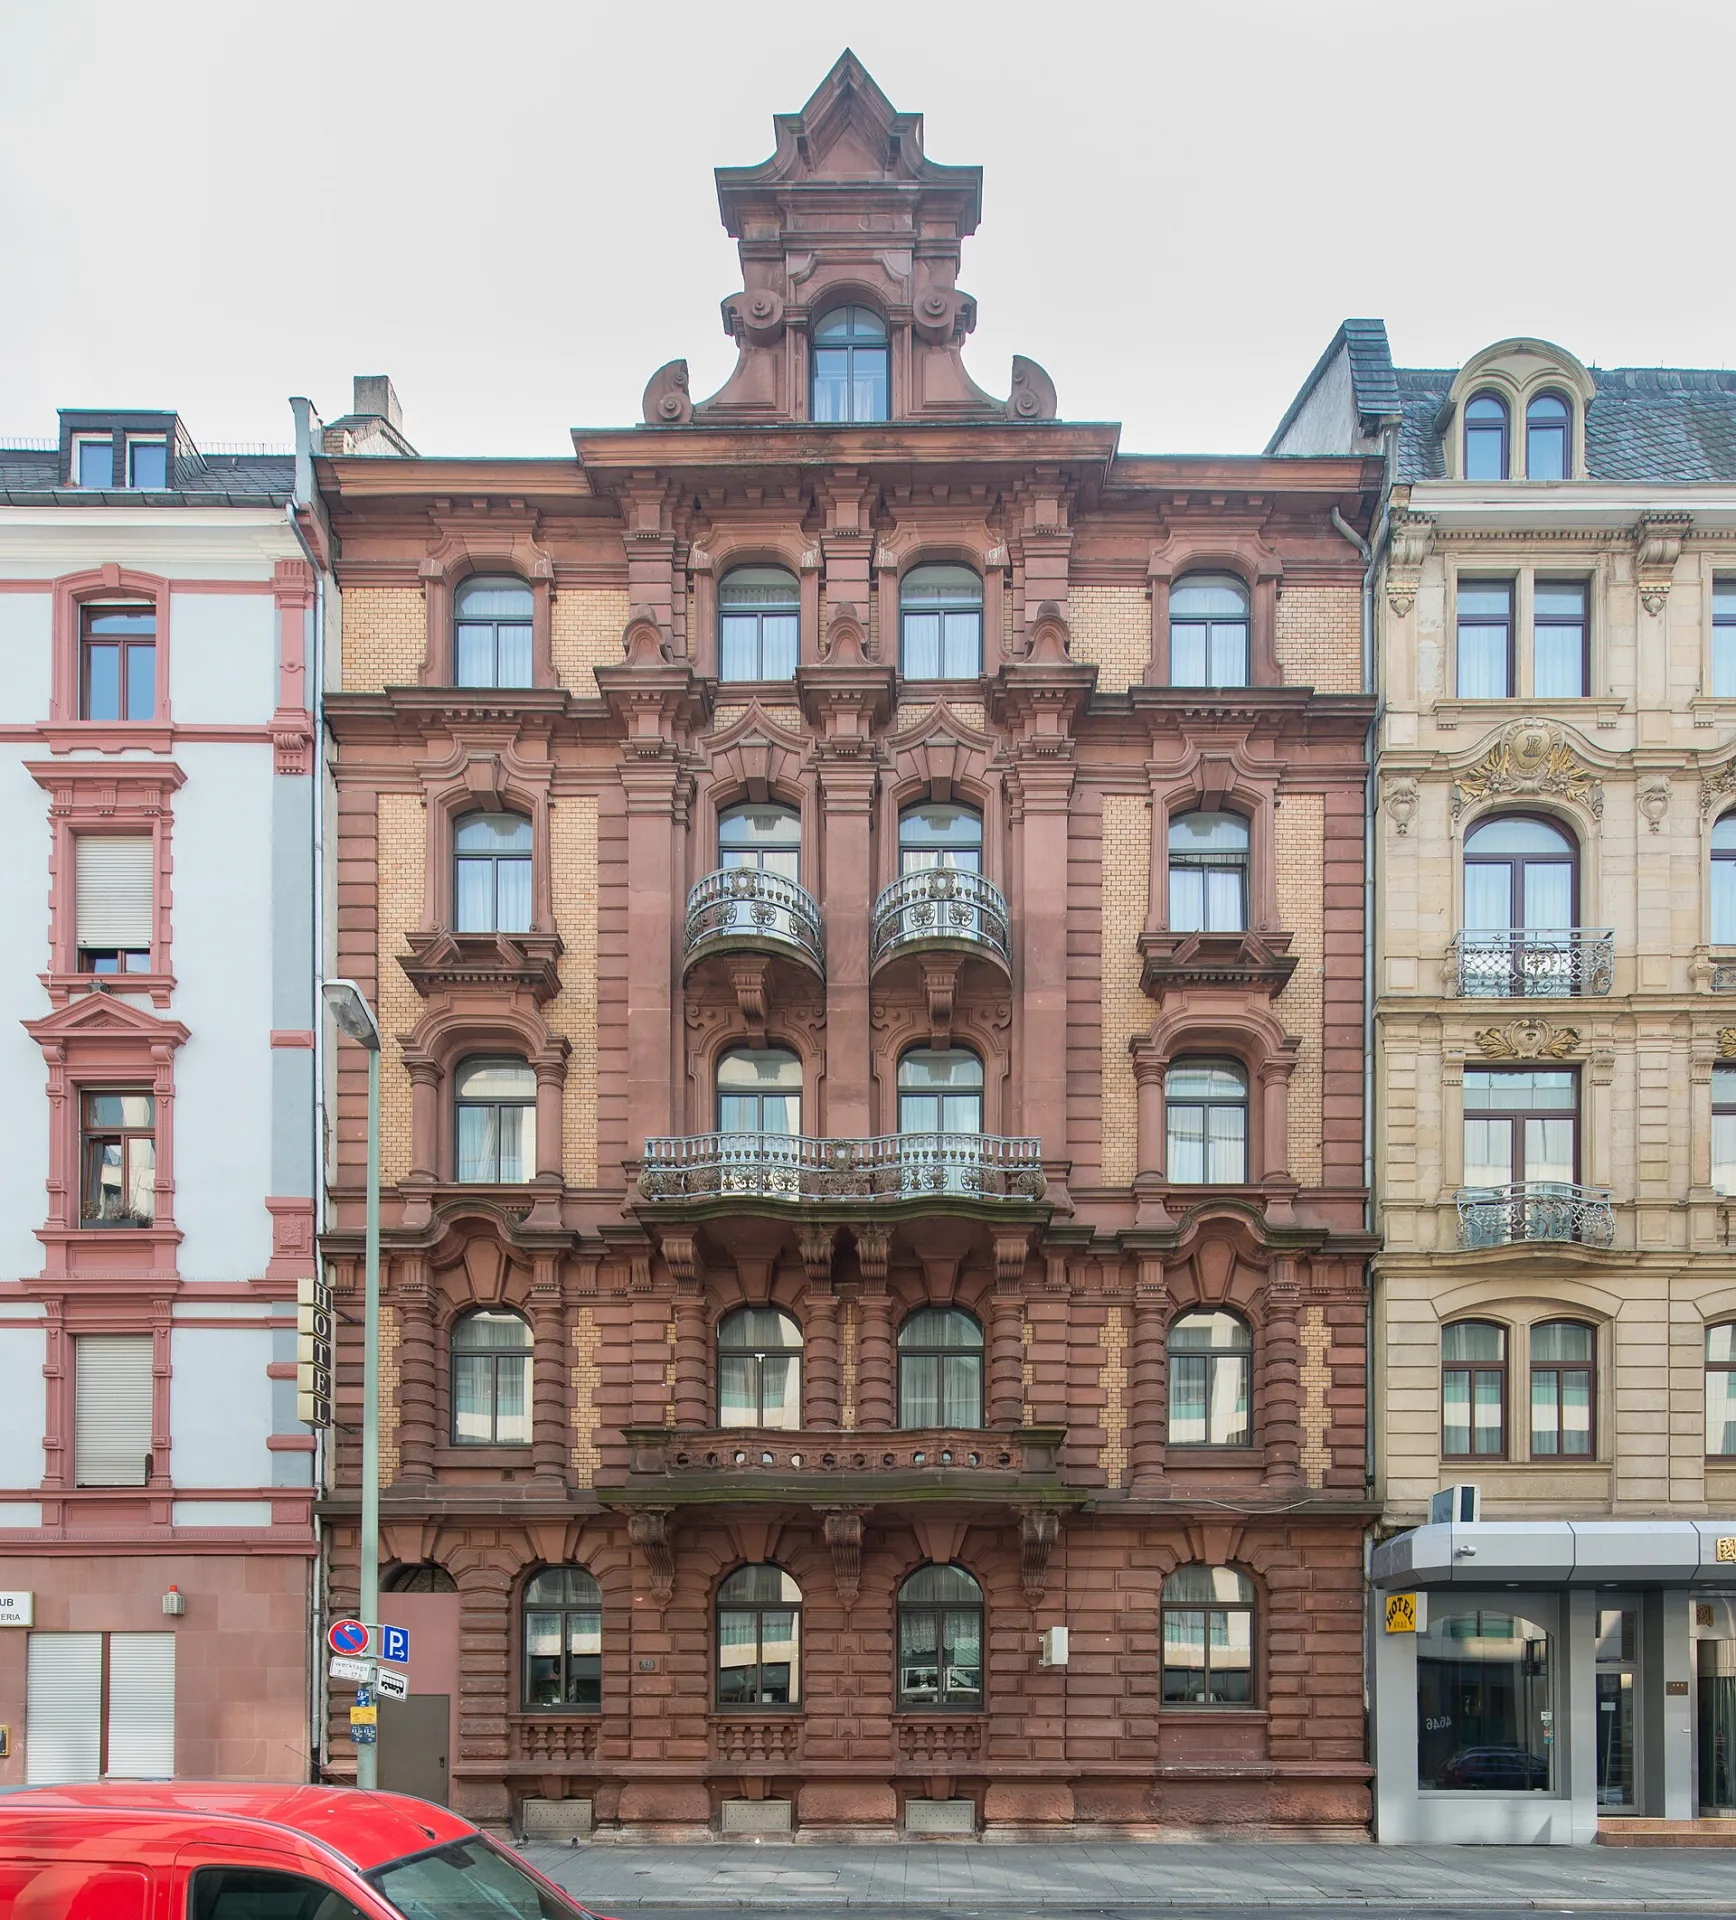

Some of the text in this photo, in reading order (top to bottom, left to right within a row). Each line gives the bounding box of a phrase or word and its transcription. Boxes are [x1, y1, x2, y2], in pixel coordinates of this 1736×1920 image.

[314, 1282, 328, 1424] HOTEL
[0, 1613, 21, 1621] ERIA
[1386, 1597, 1413, 1628] HOTEL
[389, 1630, 404, 1657] P
[335, 1661, 368, 1672] werktags
